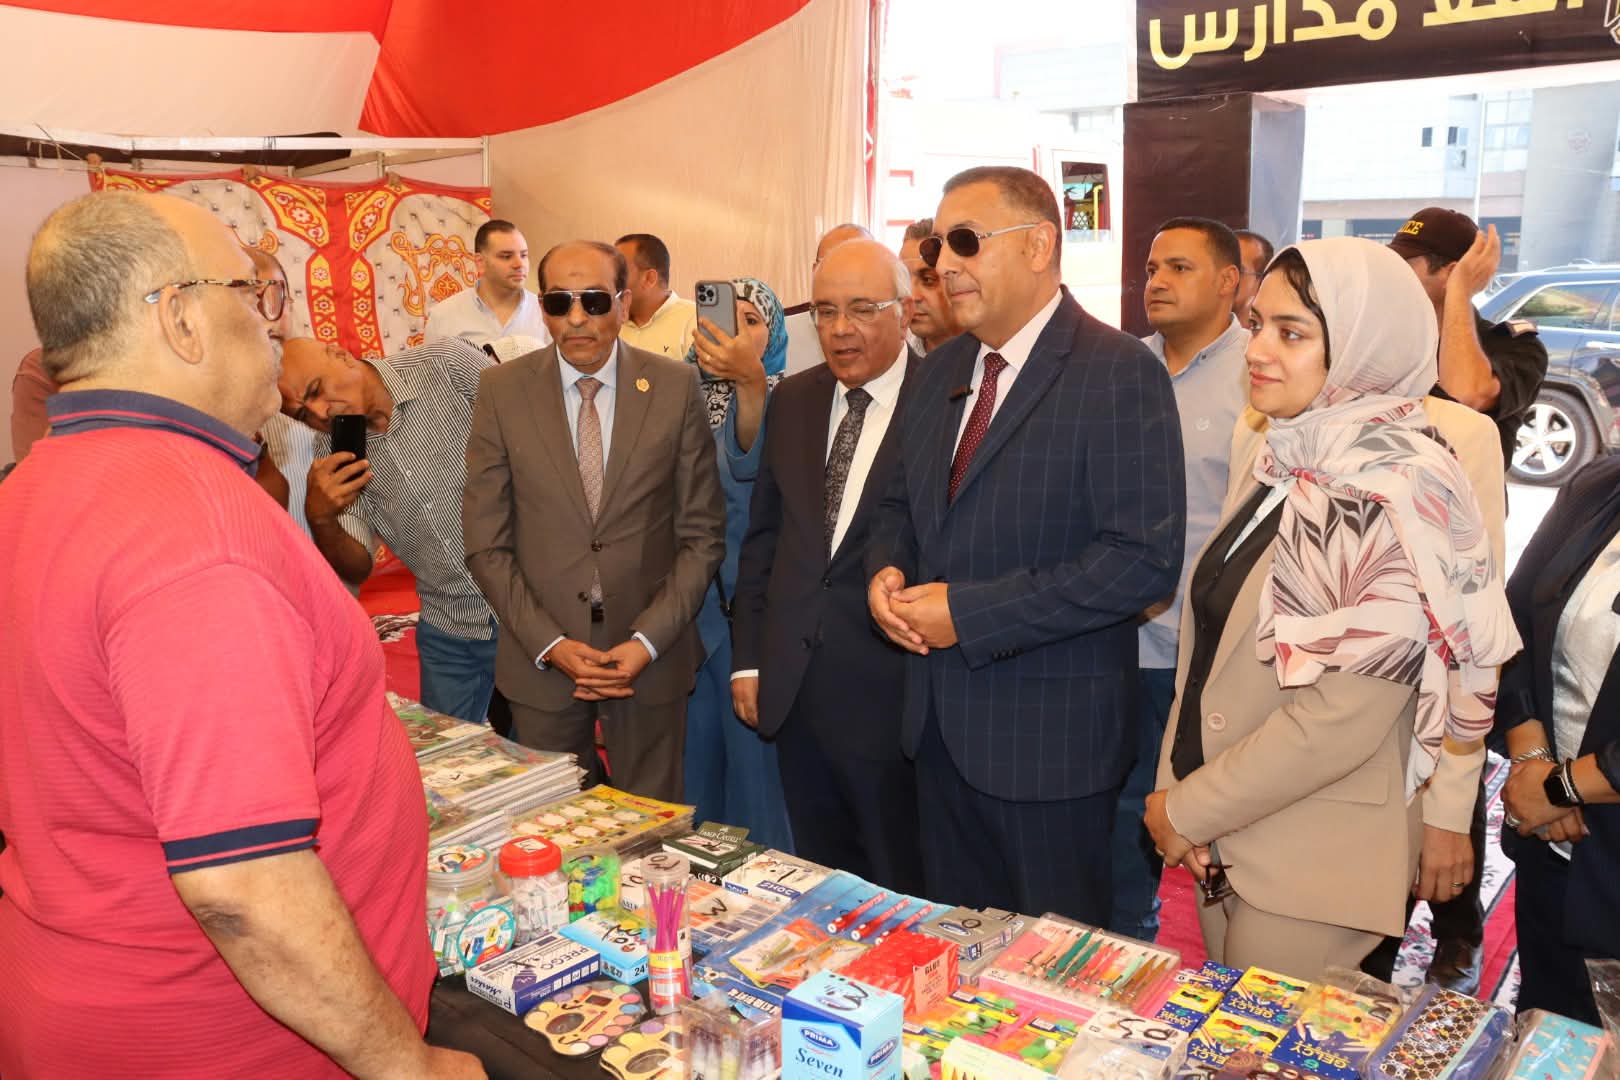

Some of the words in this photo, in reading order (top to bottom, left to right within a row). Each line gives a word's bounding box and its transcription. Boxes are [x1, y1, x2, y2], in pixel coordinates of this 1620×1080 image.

[1399, 220, 1424, 236] ICE
[541, 946, 589, 971] PREGO
[804, 1029, 834, 1047] PRIMA
[795, 1047, 844, 1079] Seven
[870, 1040, 894, 1063] PRIMA
[1188, 1043, 1229, 1065] ELCY
[1289, 1040, 1352, 1068] GELCY
